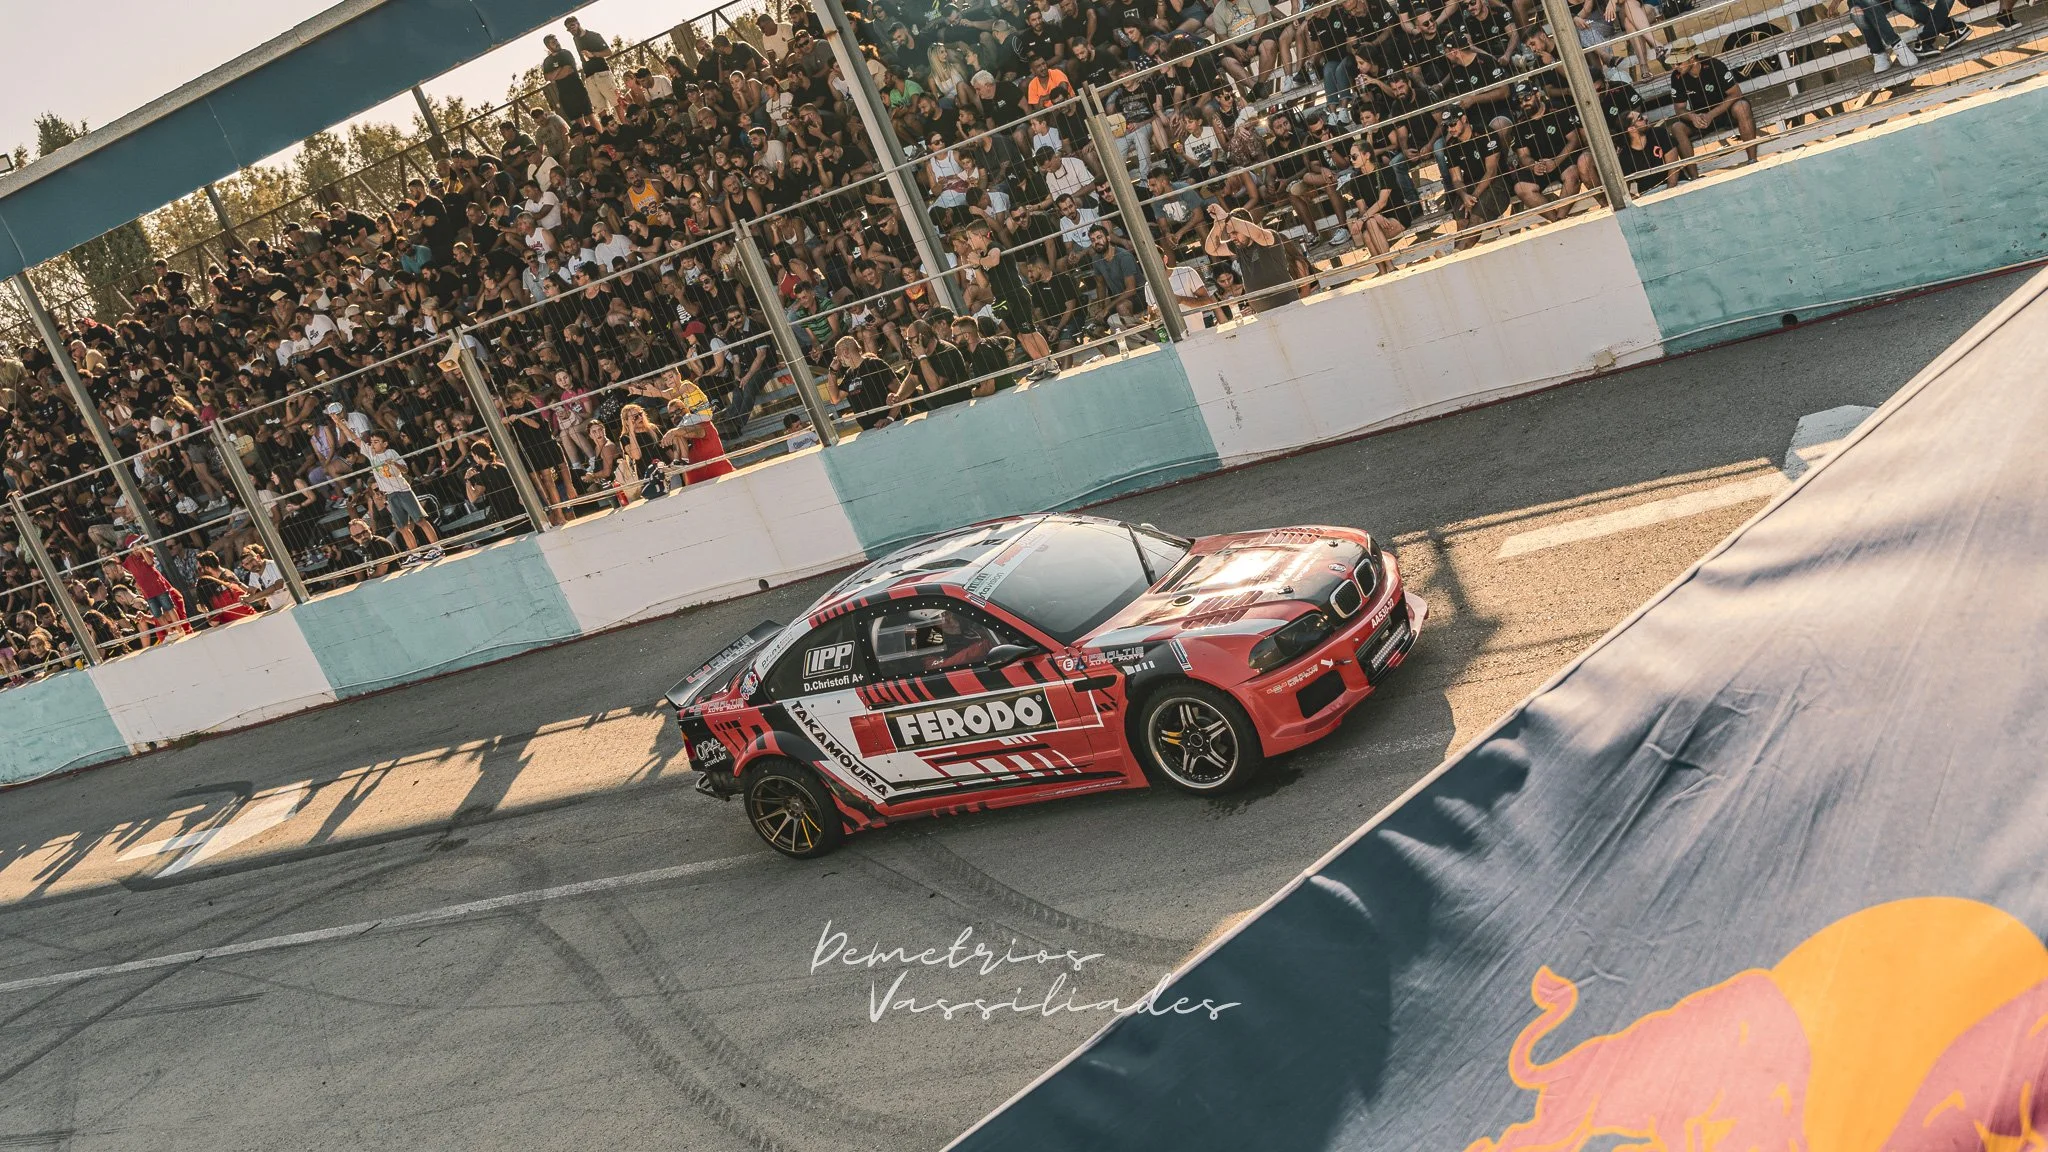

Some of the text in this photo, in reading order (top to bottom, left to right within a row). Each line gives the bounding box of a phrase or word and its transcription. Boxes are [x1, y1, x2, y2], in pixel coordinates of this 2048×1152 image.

[810, 643, 853, 672] IPP
[803, 673, 864, 692] D.Christofi A+
[896, 697, 1043, 745] FERODO
[791, 700, 888, 797] TAKAMOURA
